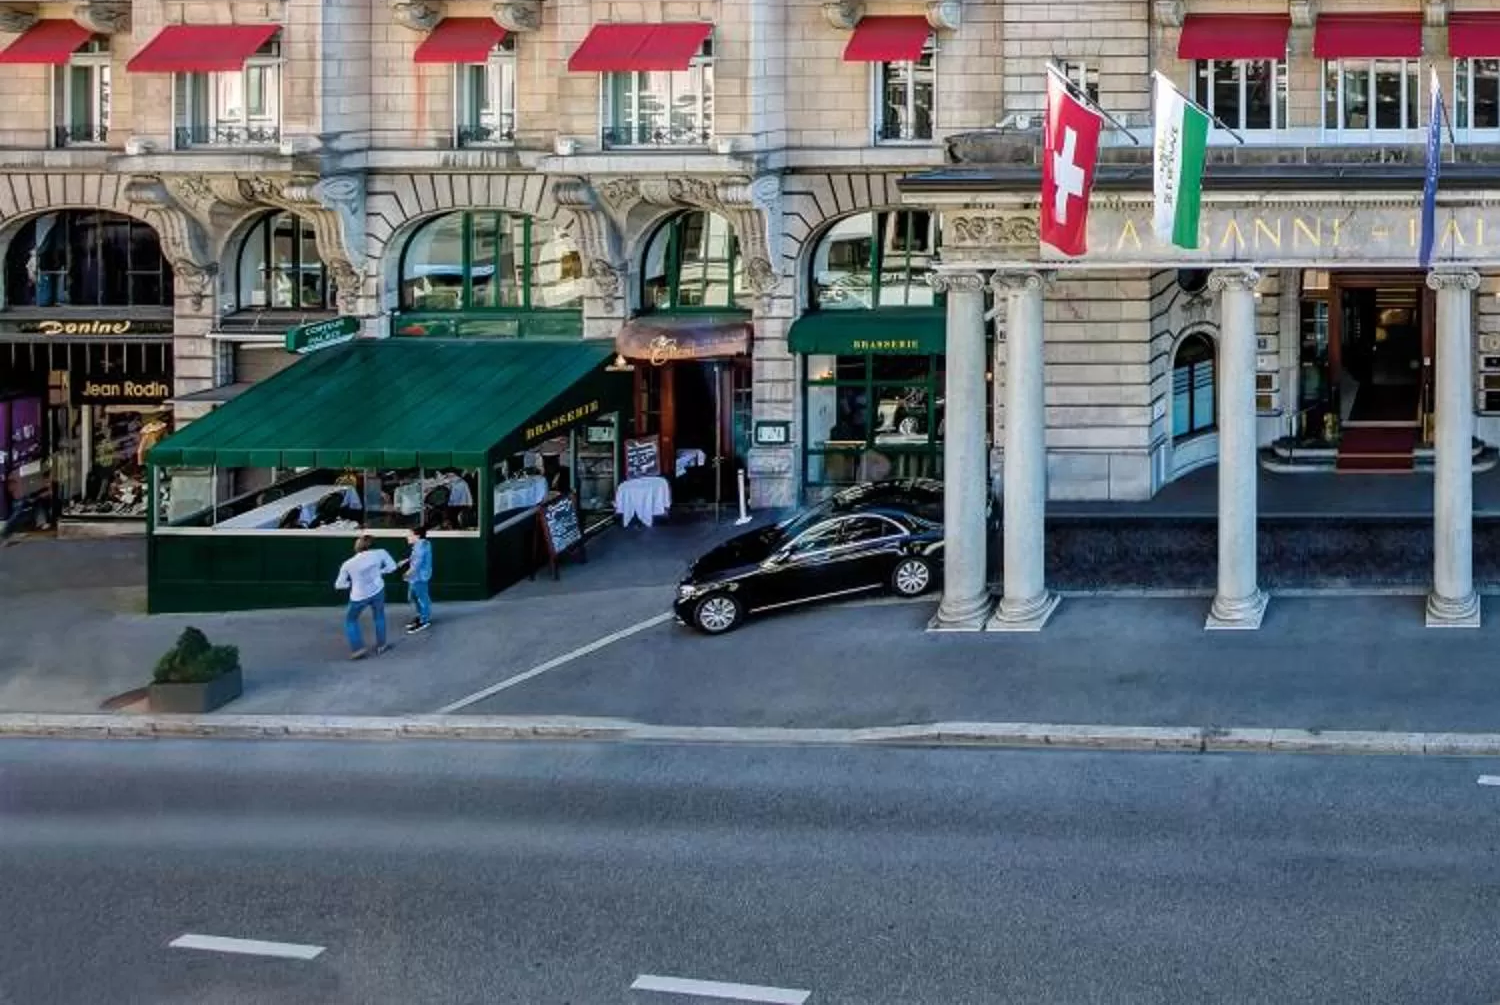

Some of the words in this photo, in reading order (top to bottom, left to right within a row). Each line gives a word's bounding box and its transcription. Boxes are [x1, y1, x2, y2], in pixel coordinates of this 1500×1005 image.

[853, 340, 919, 349] BRASSERIE
[82, 381, 120, 396] Jean
[124, 381, 169, 396] Rodin
[525, 399, 600, 441] BRASSERIE
